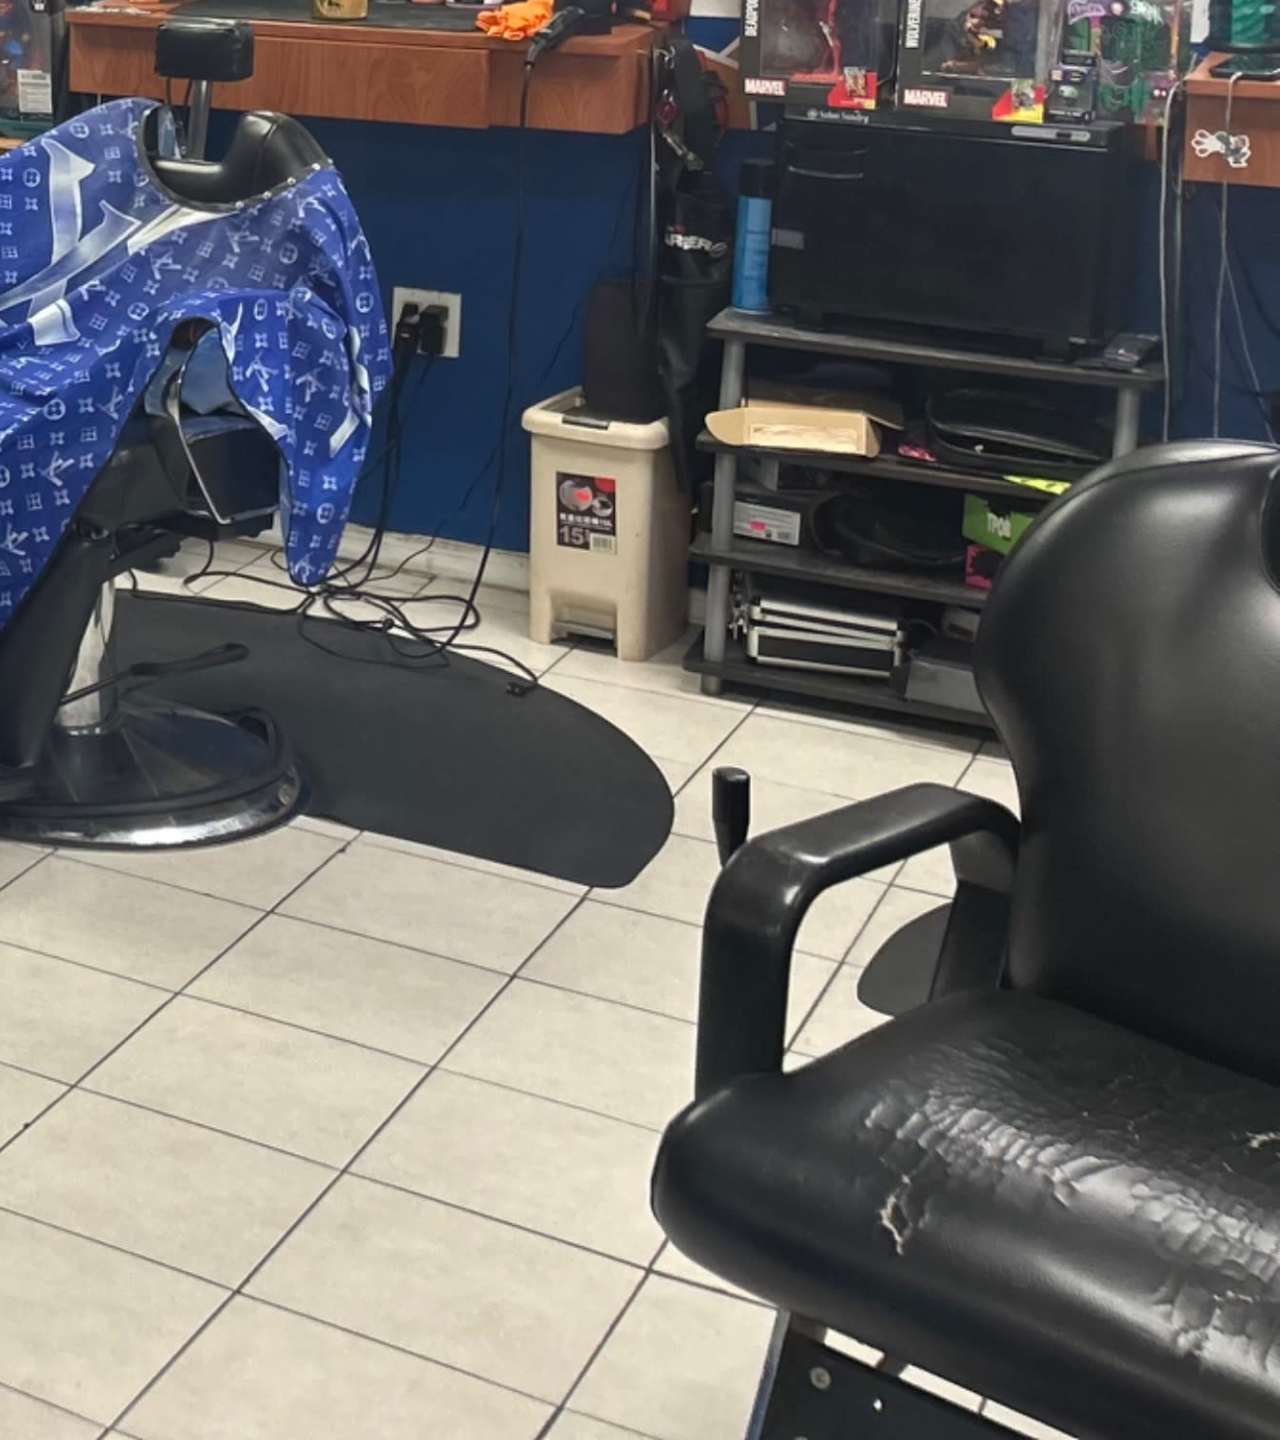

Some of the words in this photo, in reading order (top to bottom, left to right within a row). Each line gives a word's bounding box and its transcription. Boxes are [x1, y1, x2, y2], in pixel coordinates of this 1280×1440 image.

[744, 79, 786, 96] MARVEL
[904, 90, 948, 108] MARVEL
[560, 526, 590, 546] 15
